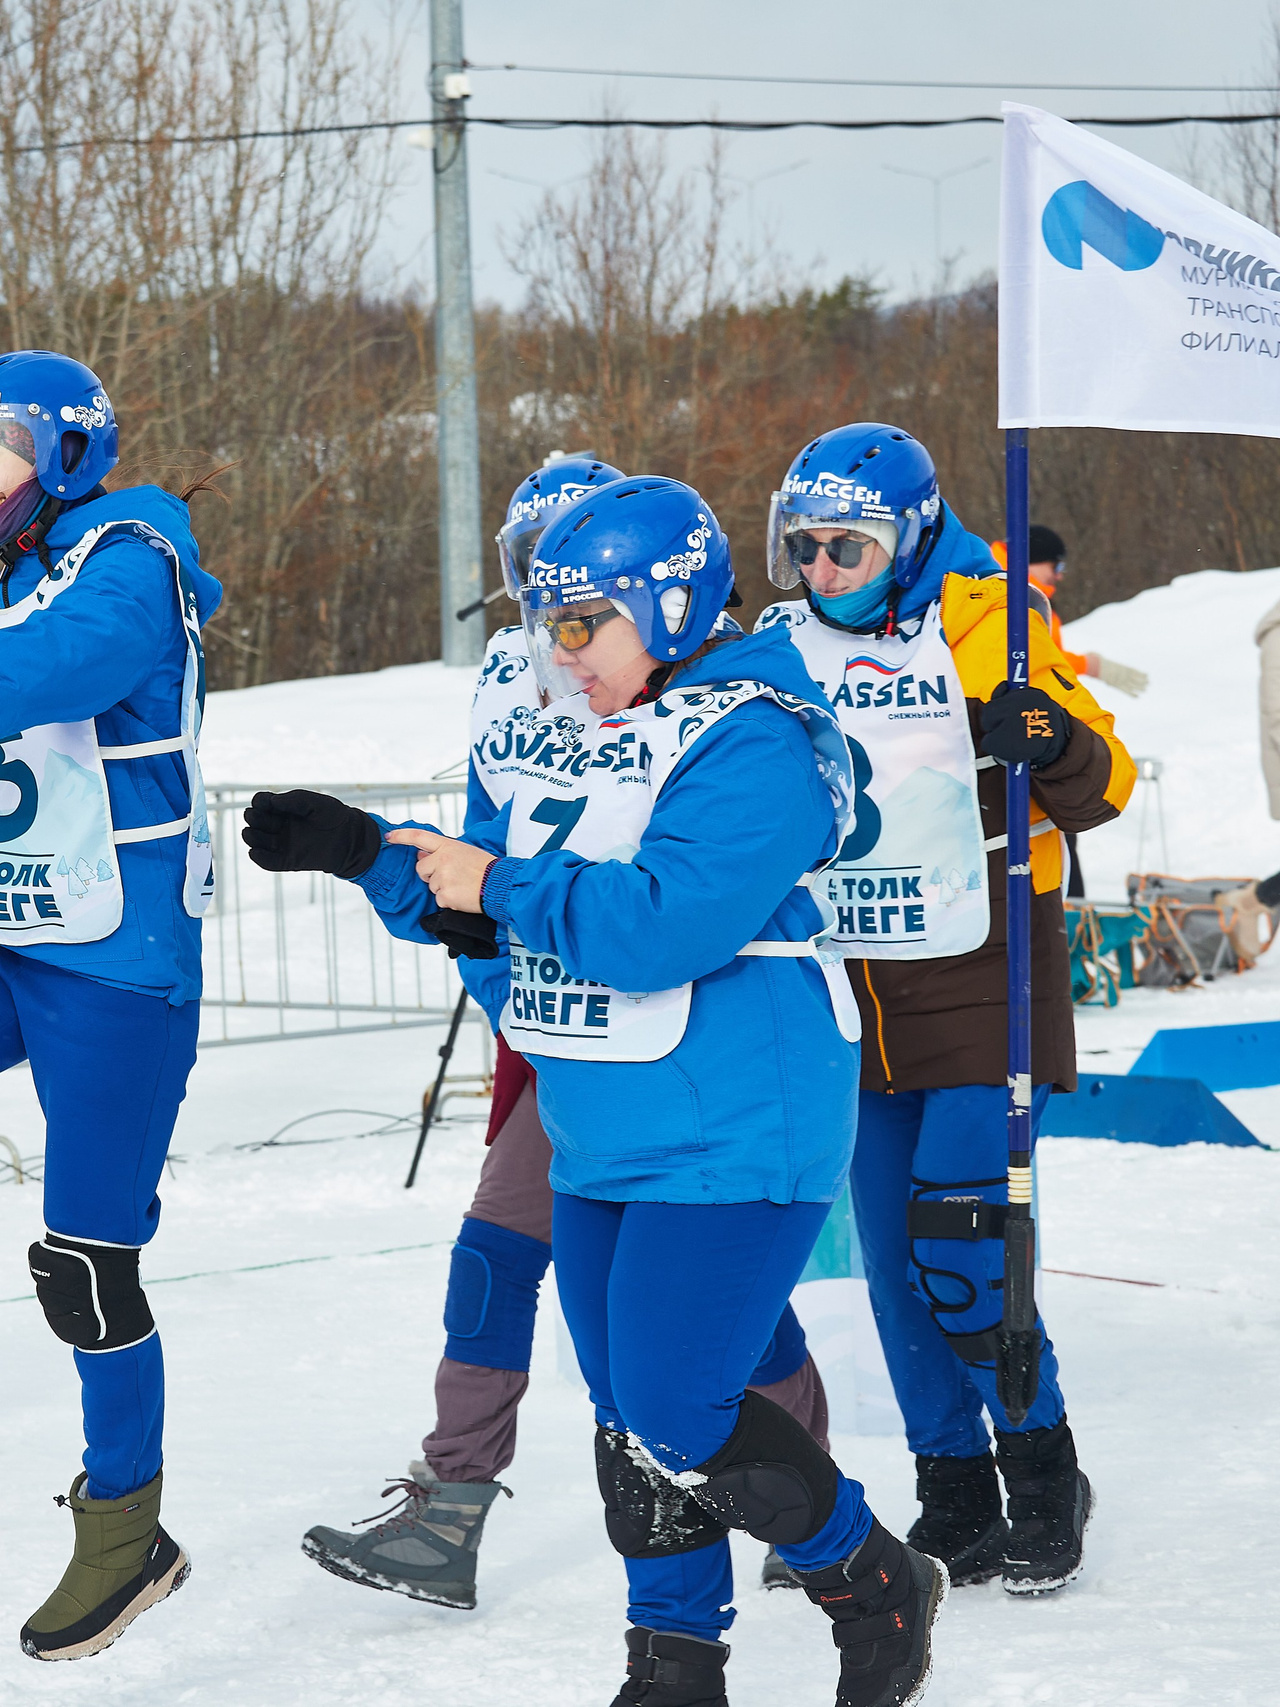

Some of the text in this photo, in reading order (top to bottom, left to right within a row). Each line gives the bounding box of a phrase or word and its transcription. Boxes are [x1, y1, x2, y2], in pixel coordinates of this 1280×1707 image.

[888, 710, 951, 720] СНЕЖНЫЙ БОЙ
[529, 795, 589, 859] 7
[841, 875, 924, 901] ТОЛК
[836, 904, 926, 934] НЕГЕ
[525, 956, 610, 988] ТО
[512, 986, 611, 1028] СНЕГЕ
